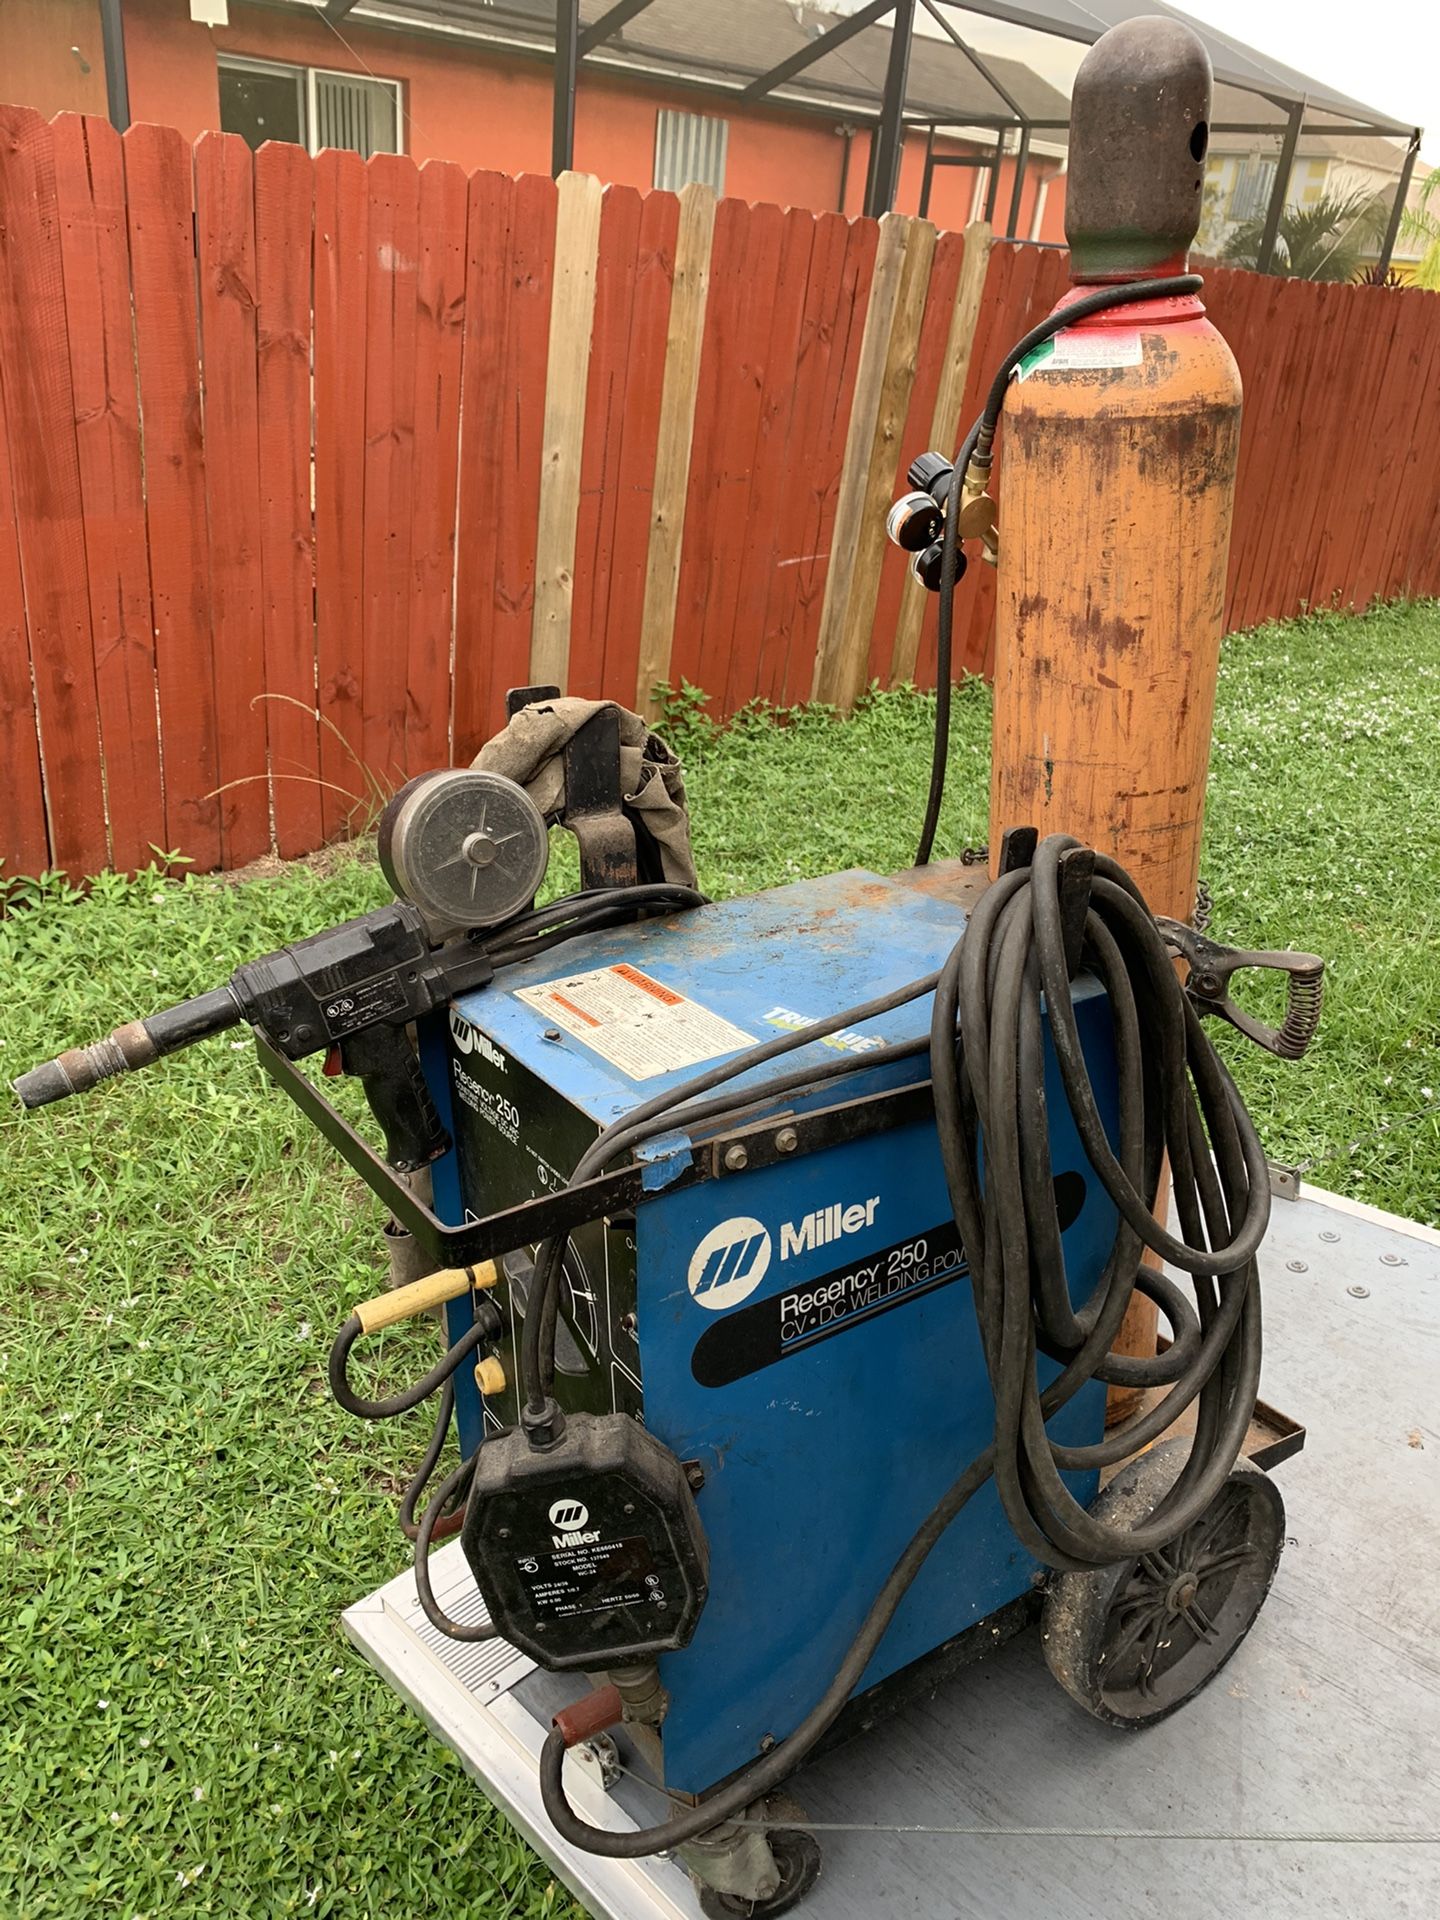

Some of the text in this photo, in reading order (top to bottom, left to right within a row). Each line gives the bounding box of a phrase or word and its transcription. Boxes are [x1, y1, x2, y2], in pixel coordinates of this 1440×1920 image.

[472, 1029, 506, 1072] Miller
[496, 1093, 520, 1129] 250
[780, 1195, 880, 1261] Miller
[887, 1239, 928, 1276] 250
[850, 1262, 930, 1310] WELDING
[551, 1530, 601, 1549] Miller
[551, 1551, 576, 1560] SERIAL
[553, 1558, 577, 1567] STOCK
[572, 1562, 597, 1571] MODEL
[531, 1582, 552, 1590] VOLTS
[535, 1589, 565, 1598] AMPERES
[555, 1604, 577, 1612] PHASE
[601, 1595, 623, 1604] HERTZ
